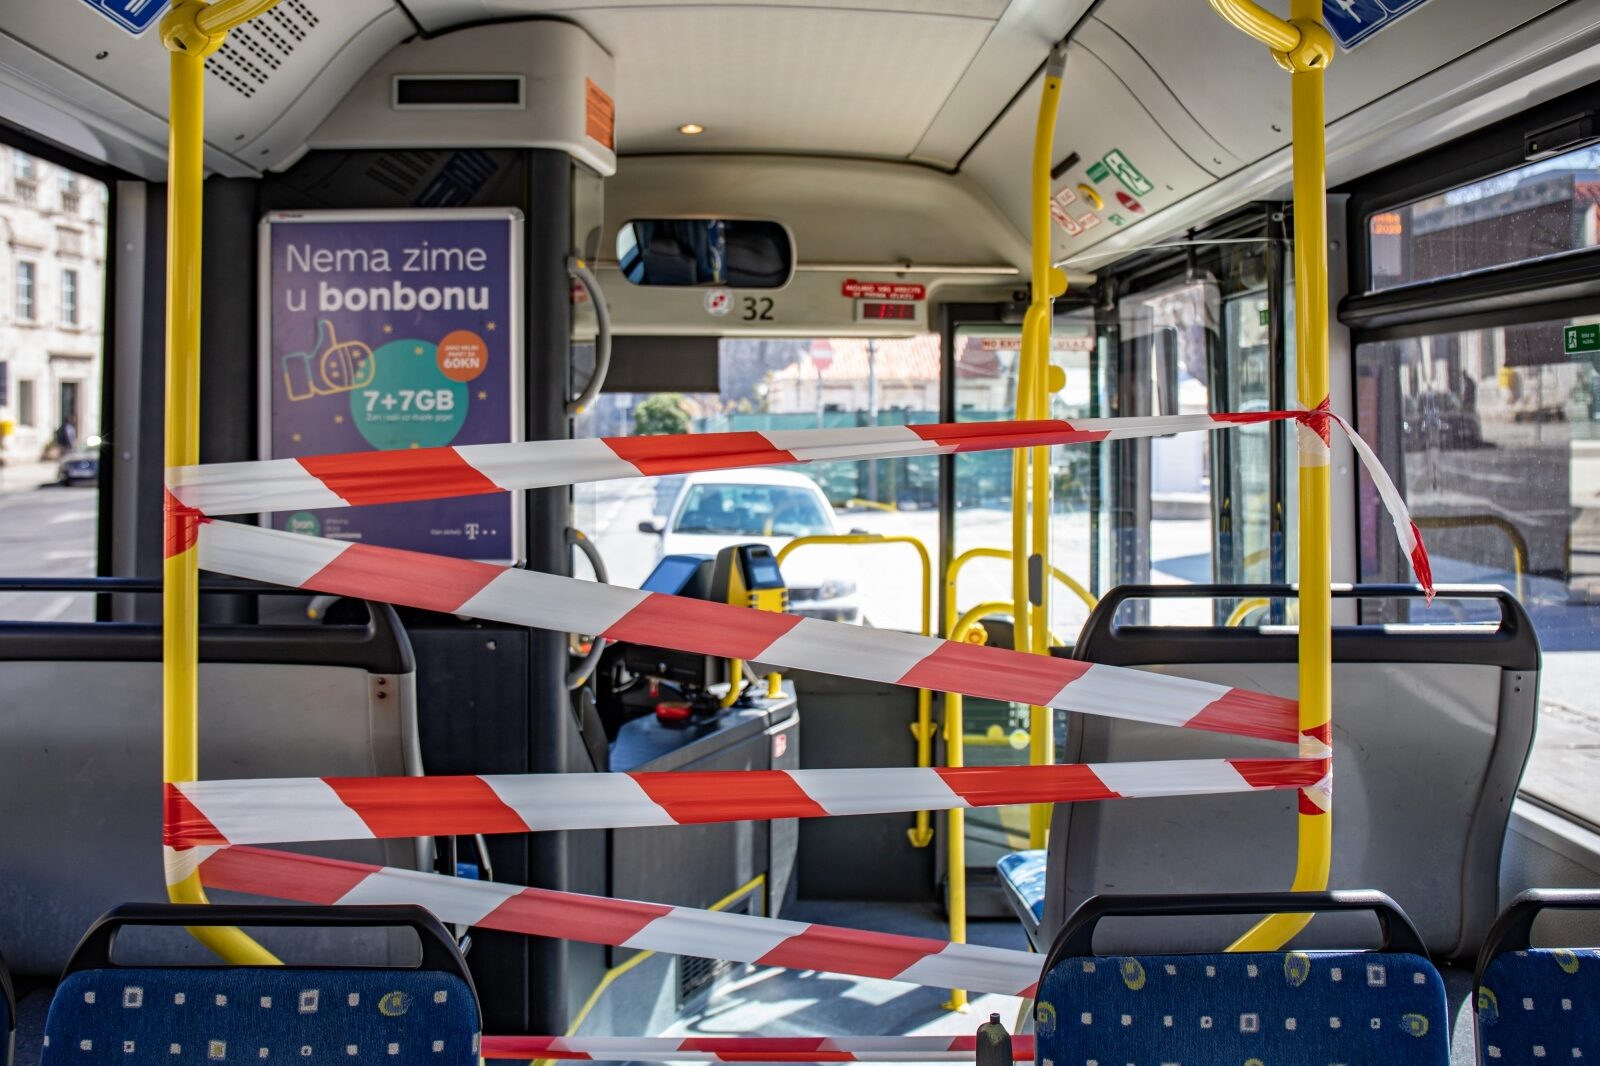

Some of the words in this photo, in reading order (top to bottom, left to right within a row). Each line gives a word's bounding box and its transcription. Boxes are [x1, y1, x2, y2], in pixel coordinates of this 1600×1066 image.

[286, 244, 391, 272] Nema
[402, 241, 487, 272] zime
[286, 289, 306, 311] u
[319, 281, 489, 311] bonbonu
[742, 297, 775, 321] 32
[443, 358, 480, 369] 60KN
[363, 389, 455, 412] 7+7GB
